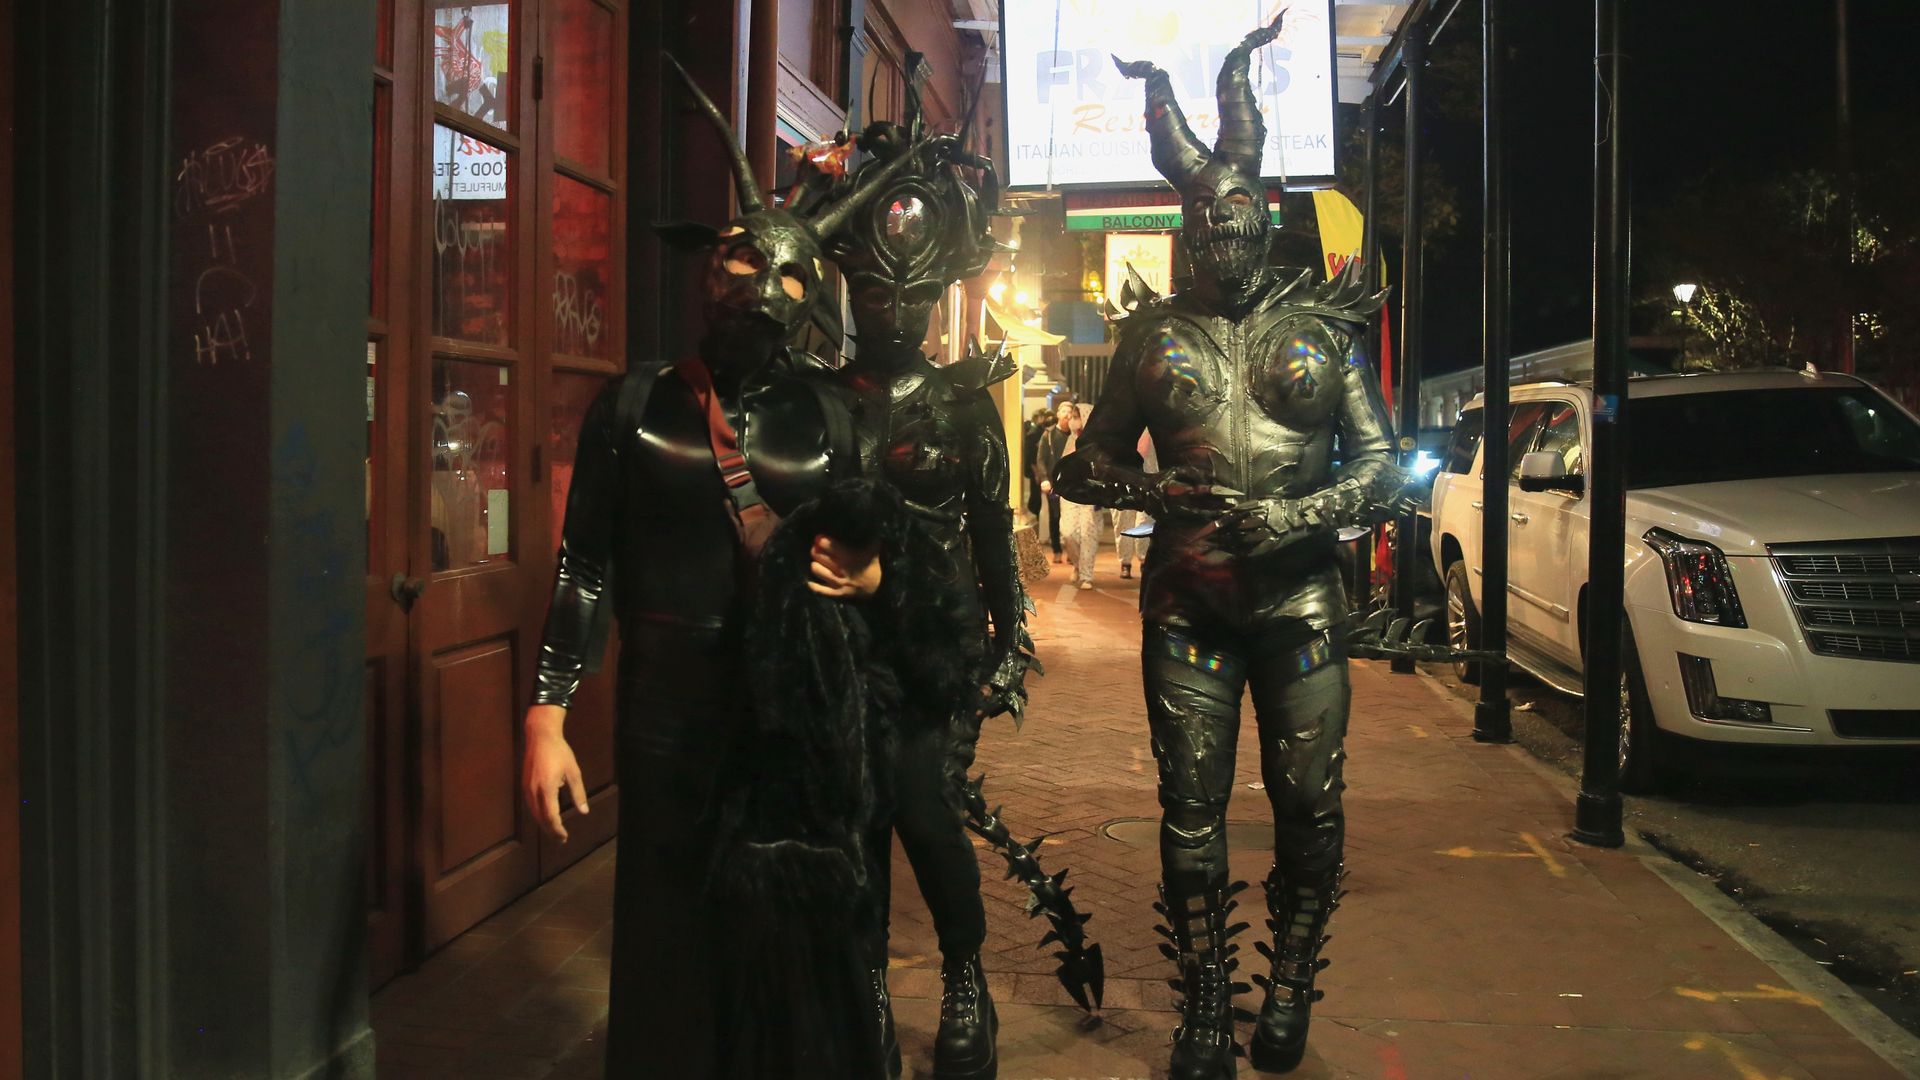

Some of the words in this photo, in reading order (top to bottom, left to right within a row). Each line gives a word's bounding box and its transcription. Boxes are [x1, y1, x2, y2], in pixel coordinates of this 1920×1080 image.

[1017, 143, 1083, 161] ITALIAN
[1089, 140, 1149, 158] CUISIN
[1271, 135, 1327, 150] STEAK
[1102, 215, 1175, 229] BALCONY
